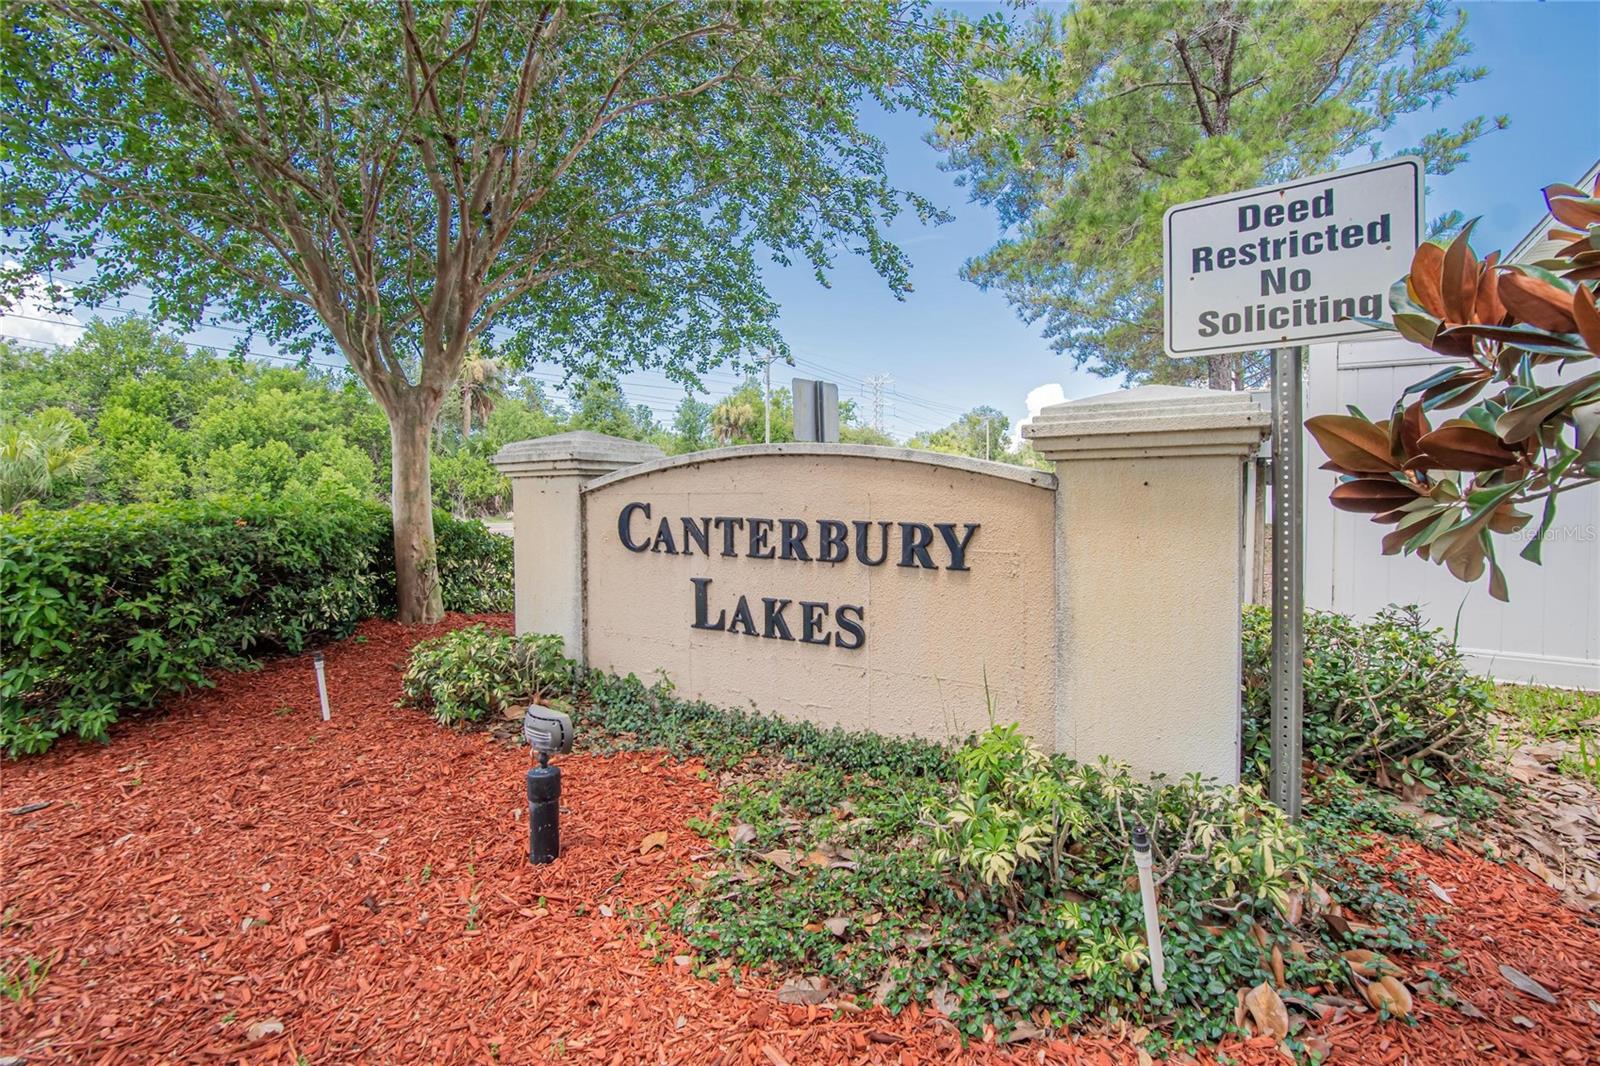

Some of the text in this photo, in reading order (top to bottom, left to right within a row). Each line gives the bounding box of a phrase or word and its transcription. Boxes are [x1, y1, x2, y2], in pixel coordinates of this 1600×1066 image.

[1238, 188, 1334, 233] Deed
[1192, 213, 1391, 274] Restricted
[1260, 266, 1312, 297] No
[1198, 293, 1383, 338] Soliciting
[617, 502, 981, 571] CANTERBURY
[690, 577, 867, 650] LAKES
